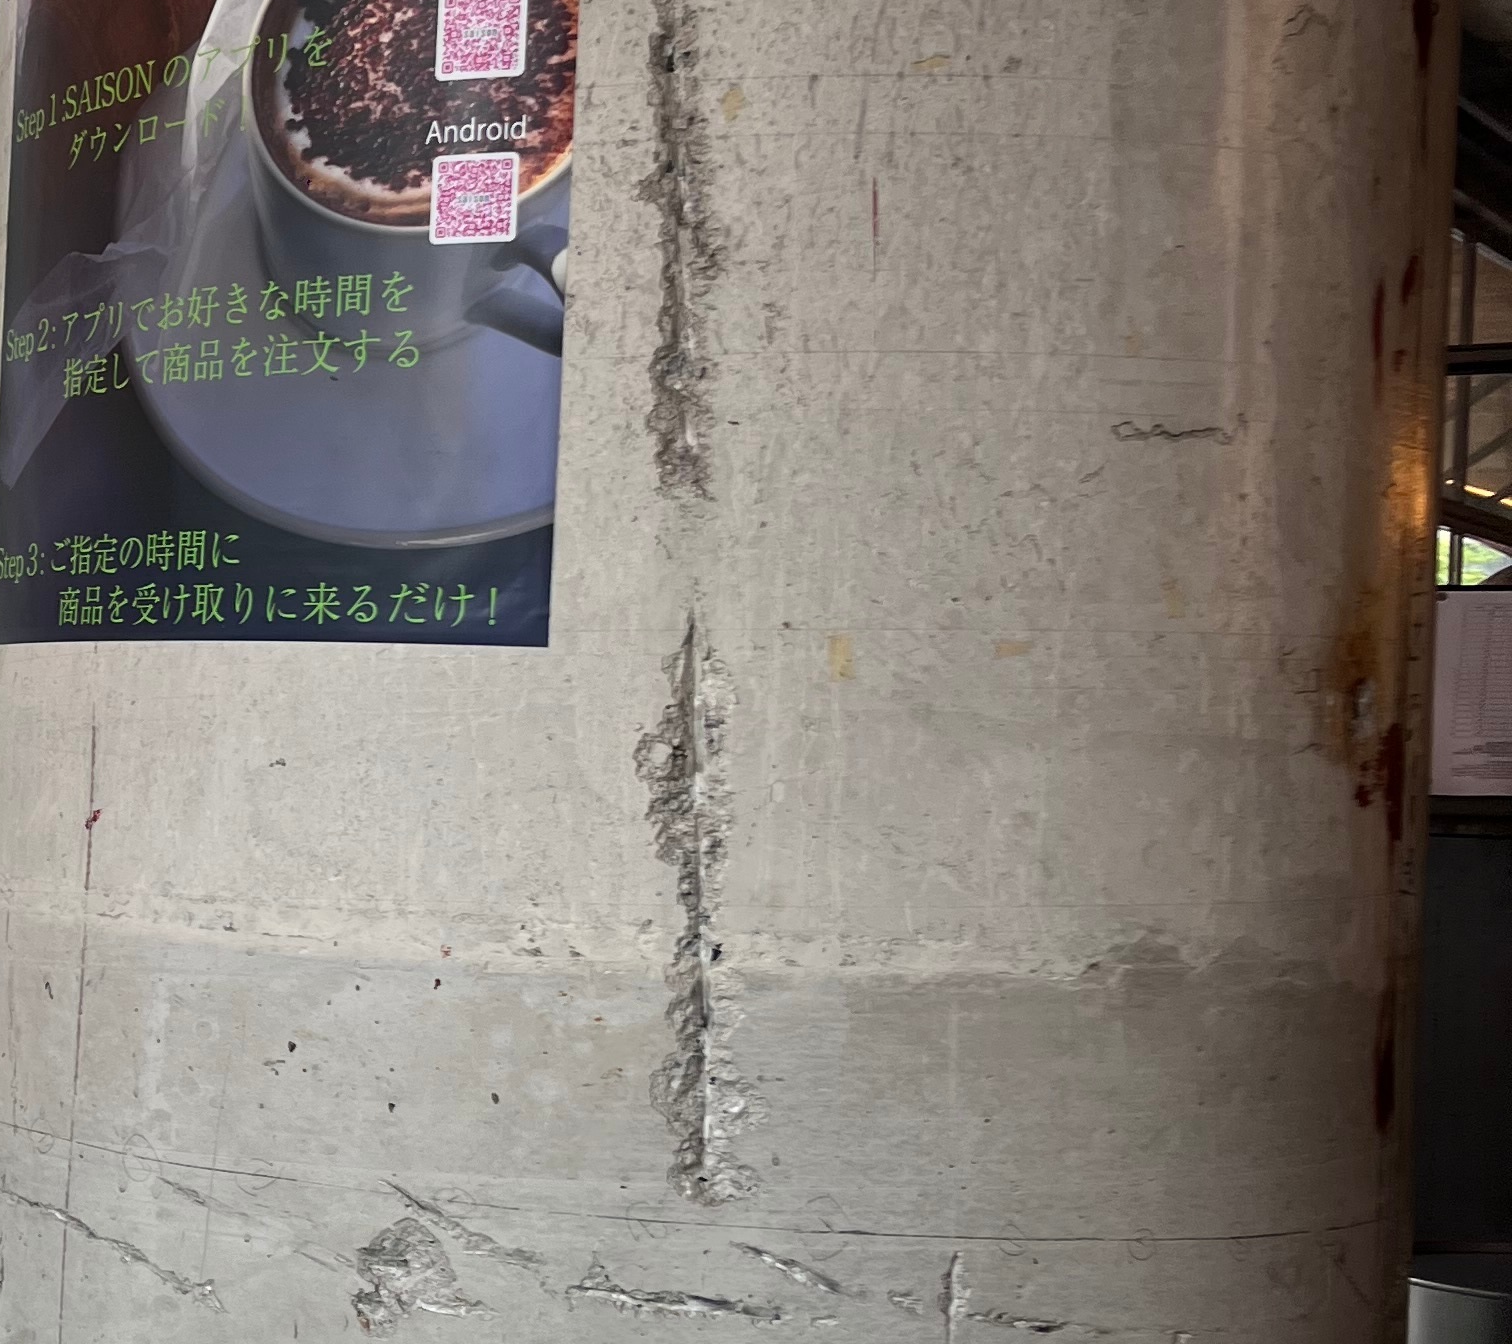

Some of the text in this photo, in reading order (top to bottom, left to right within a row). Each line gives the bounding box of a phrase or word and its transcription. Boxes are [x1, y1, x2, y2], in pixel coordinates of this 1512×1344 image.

[15, 109, 45, 143] Step
[424, 113, 528, 145] Android
[6, 328, 35, 364] Step
[61, 329, 421, 400] 指定して商品を注文する
